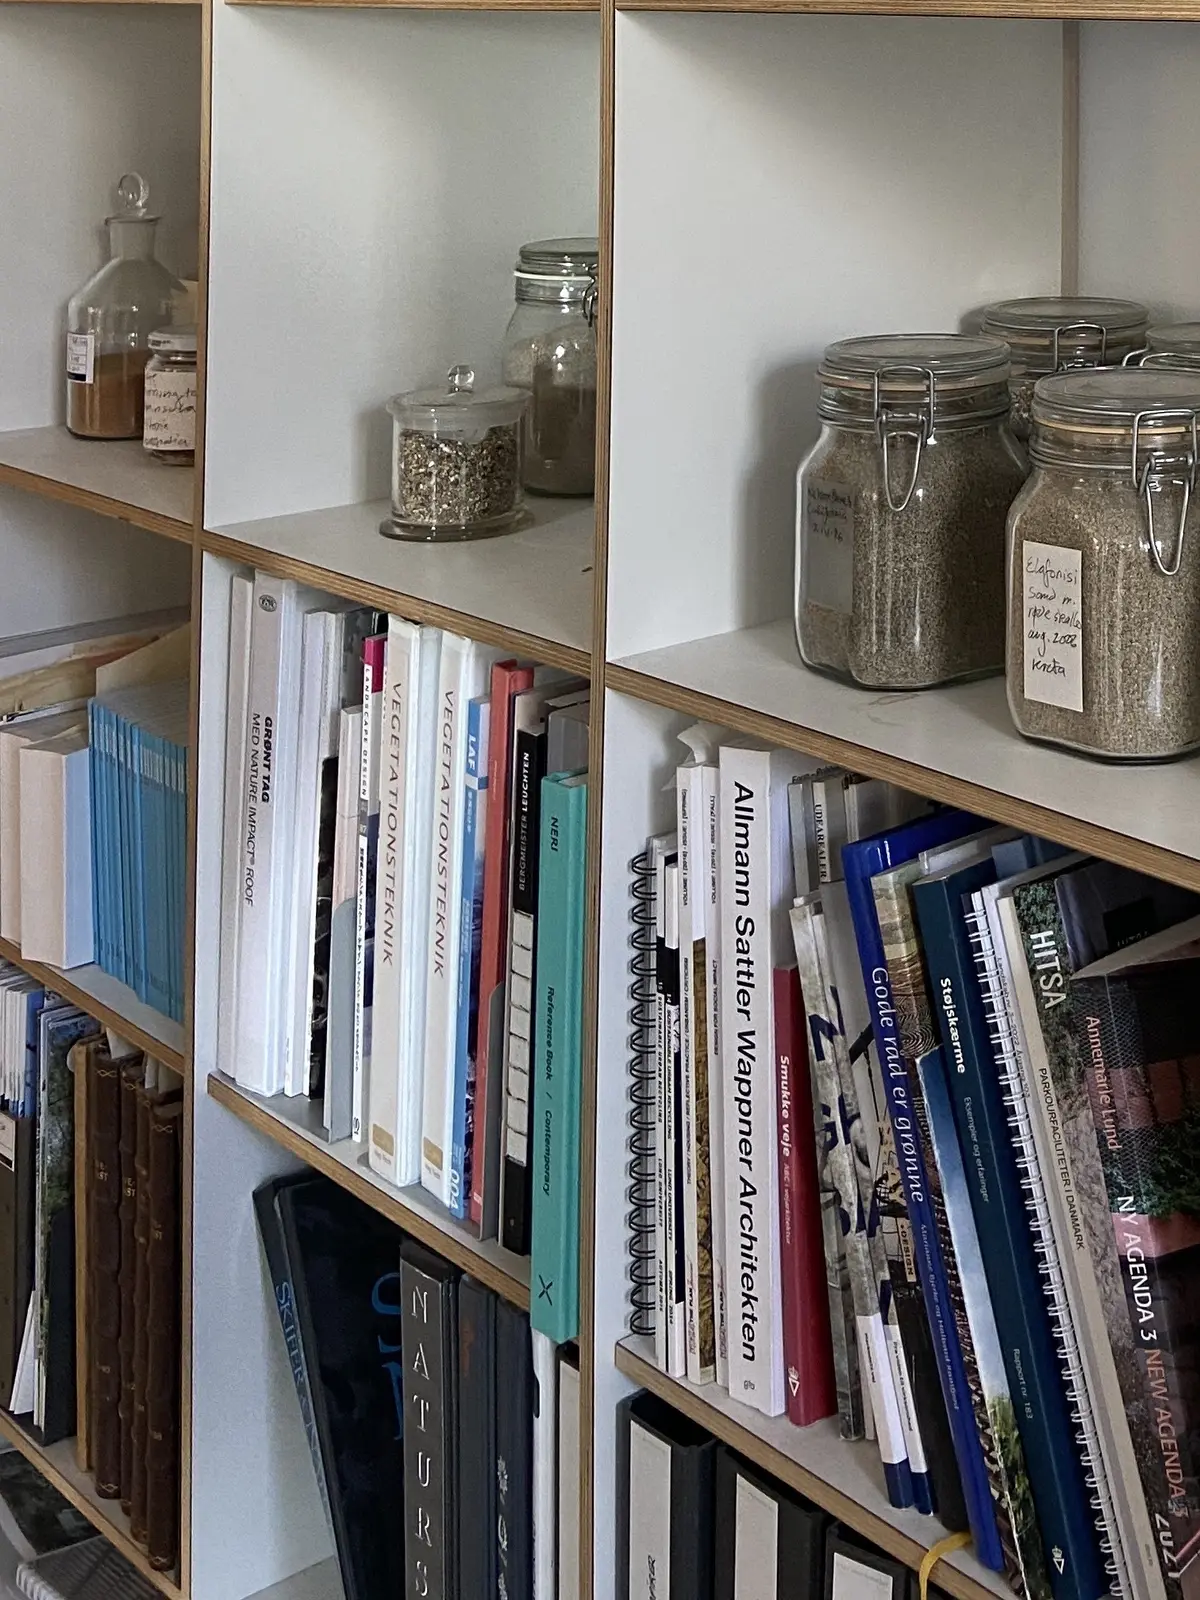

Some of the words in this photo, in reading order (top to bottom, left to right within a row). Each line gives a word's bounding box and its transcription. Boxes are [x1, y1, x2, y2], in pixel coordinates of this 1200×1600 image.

[251, 713, 261, 746] MED
[362, 667, 371, 746] LANDSCAPE
[249, 748, 259, 803] NATURE
[262, 715, 273, 770] GRØNT
[466, 733, 477, 771] LAF
[261, 773, 271, 803] TAG
[521, 751, 530, 813] LEUCHTEN
[382, 681, 402, 966] VEGETATIONSTEKNIK
[433, 690, 454, 980] VEGETATIONSTEKNIK
[518, 815, 530, 892] BERGMEISTER
[550, 815, 559, 853] NERI
[733, 780, 756, 909] Allmann
[244, 867, 255, 906] ROOF
[734, 913, 757, 1023] Sattler
[871, 967, 897, 1028] Gode
[1029, 929, 1068, 1010] HITSA
[545, 986, 556, 1048] Reference
[544, 1050, 554, 1082] Book
[778, 1054, 790, 1121] Smukke
[940, 977, 967, 1075] Støjskærme
[963, 1095, 979, 1143] Eksempler
[1084, 1015, 1112, 1108] Annemarie
[1099, 1107, 1123, 1151] Lund
[735, 1028, 758, 1172] Wappner
[892, 1086, 908, 1109] er
[541, 1108, 555, 1197] Contemporary
[780, 1122, 792, 1158] veje
[894, 1116, 924, 1203] grønne
[1039, 1067, 1072, 1188] PARKOURFACILITETER
[1066, 1195, 1085, 1251] DANMARK
[449, 1168, 461, 1210] 004
[1116, 1195, 1139, 1227] NY
[738, 1174, 760, 1362] Architekten
[1122, 1229, 1157, 1324] AGENDA
[1145, 1348, 1169, 1401] NEW
[1153, 1408, 1189, 1502] AGENDA
